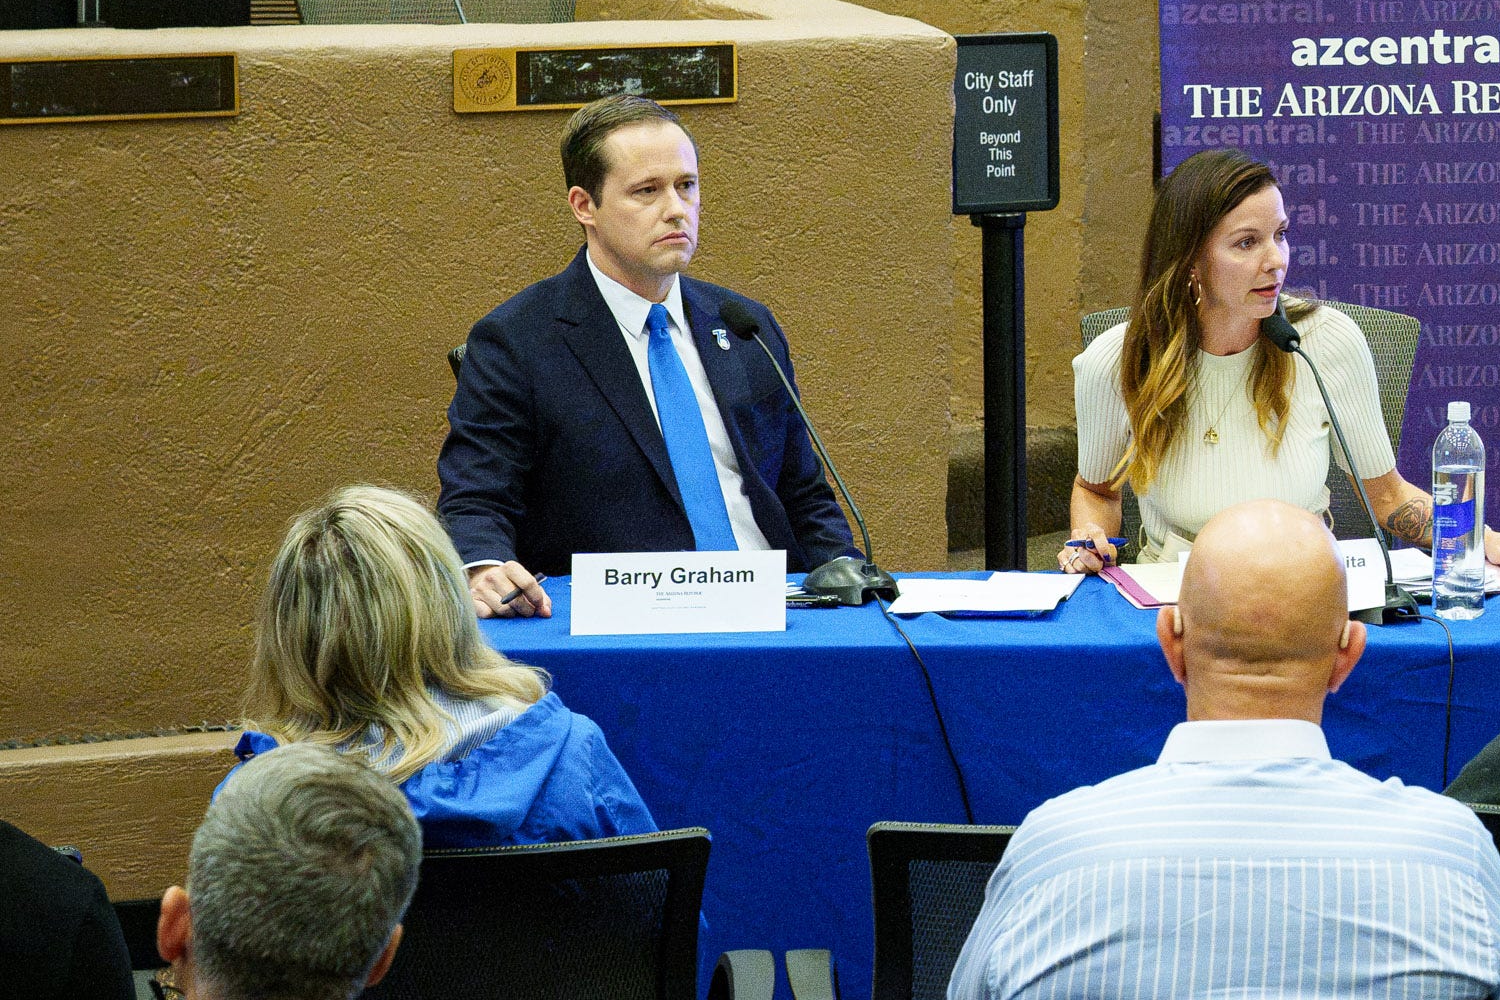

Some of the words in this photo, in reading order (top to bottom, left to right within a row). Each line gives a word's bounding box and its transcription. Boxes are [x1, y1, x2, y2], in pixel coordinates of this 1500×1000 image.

[1348, 0, 1404, 23] THE
[964, 72, 994, 93] City
[998, 69, 1034, 89] Staff
[982, 95, 1017, 116] Only
[1182, 83, 1264, 119] THE
[1271, 81, 1443, 117] ARIZONA
[980, 130, 1021, 147] Beyond
[1164, 118, 1337, 146] azcentral.
[1350, 120, 1406, 145] THE
[988, 148, 1013, 161] This
[986, 164, 1016, 178] Point
[1351, 162, 1407, 185] THE
[1352, 202, 1408, 226] THE
[1352, 243, 1408, 267] THE
[1345, 555, 1367, 569] ita
[604, 568, 663, 589] Barry
[670, 566, 755, 585] Graham
